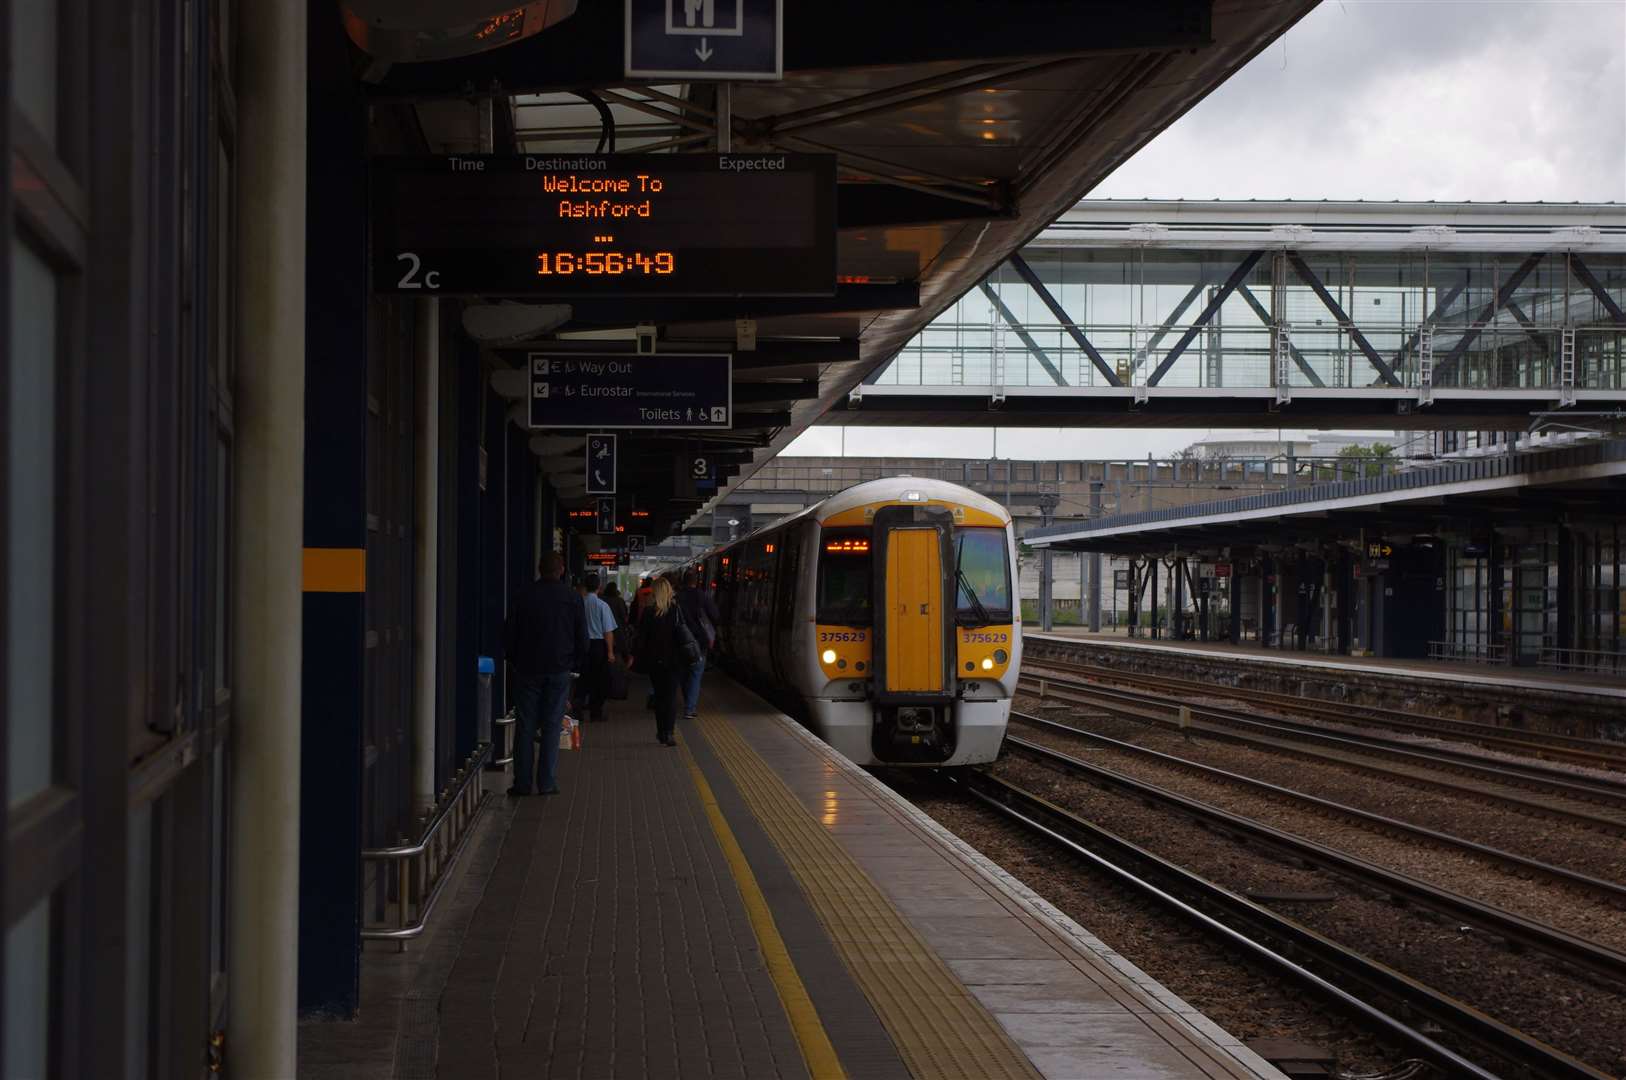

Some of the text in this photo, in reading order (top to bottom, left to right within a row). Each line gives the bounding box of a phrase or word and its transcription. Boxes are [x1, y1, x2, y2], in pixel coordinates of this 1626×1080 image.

[449, 157, 485, 171] Time
[525, 156, 608, 171] Destination
[719, 156, 786, 173] Expected
[543, 176, 663, 193] Welcome To
[559, 201, 651, 218] Ashford
[537, 252, 676, 276] 16:56:49
[578, 361, 632, 375] Way Out
[581, 385, 633, 397] Eurostar
[639, 408, 682, 420] Toilets
[693, 458, 708, 475] 3
[820, 632, 867, 642] 375629
[963, 632, 1009, 643] 375629
